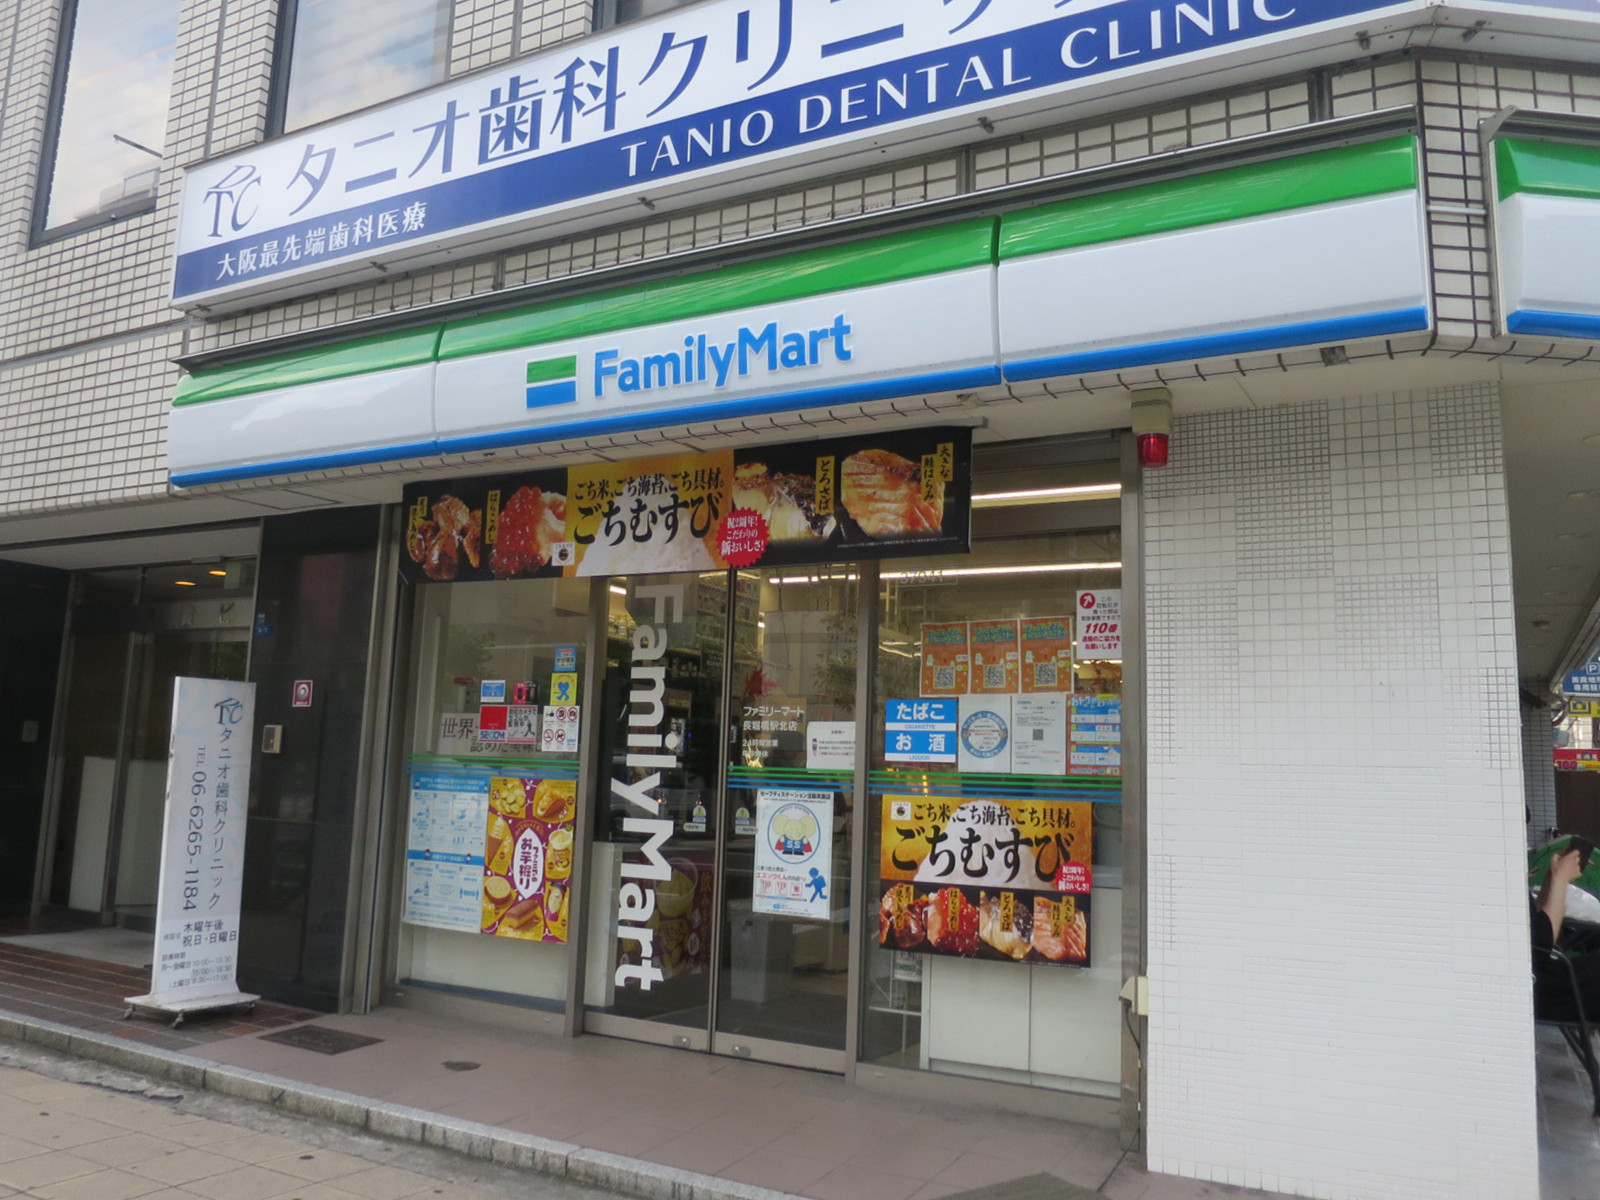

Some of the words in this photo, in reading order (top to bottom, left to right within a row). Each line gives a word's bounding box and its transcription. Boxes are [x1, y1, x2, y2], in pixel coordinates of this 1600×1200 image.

[621, 110, 775, 179] TANIO
[799, 47, 1032, 135] DENTAL
[1061, 0, 1297, 69] CLINIC
[216, 201, 427, 280] 大阪最先端歯科医療
[594, 313, 852, 397] FamilyMart
[819, 458, 833, 512] とろさば
[574, 491, 724, 546] ごちむすび
[1085, 622, 1118, 634] 110番
[1589, 664, 1598, 673] P
[442, 717, 474, 740] 世界
[480, 730, 505, 740] SECOM
[743, 706, 805, 717] ファミリーマート
[896, 703, 945, 721] たばこ
[611, 584, 684, 991] FamilyMart
[183, 771, 208, 912] 06-6265-1184
[207, 728, 233, 910] タニオ歯科クリニック
[519, 838, 533, 889] お芋掘り
[892, 824, 1075, 884] ごちむすび
[184, 920, 224, 933] 木曜午後
[1002, 894, 1011, 931] とろさば
